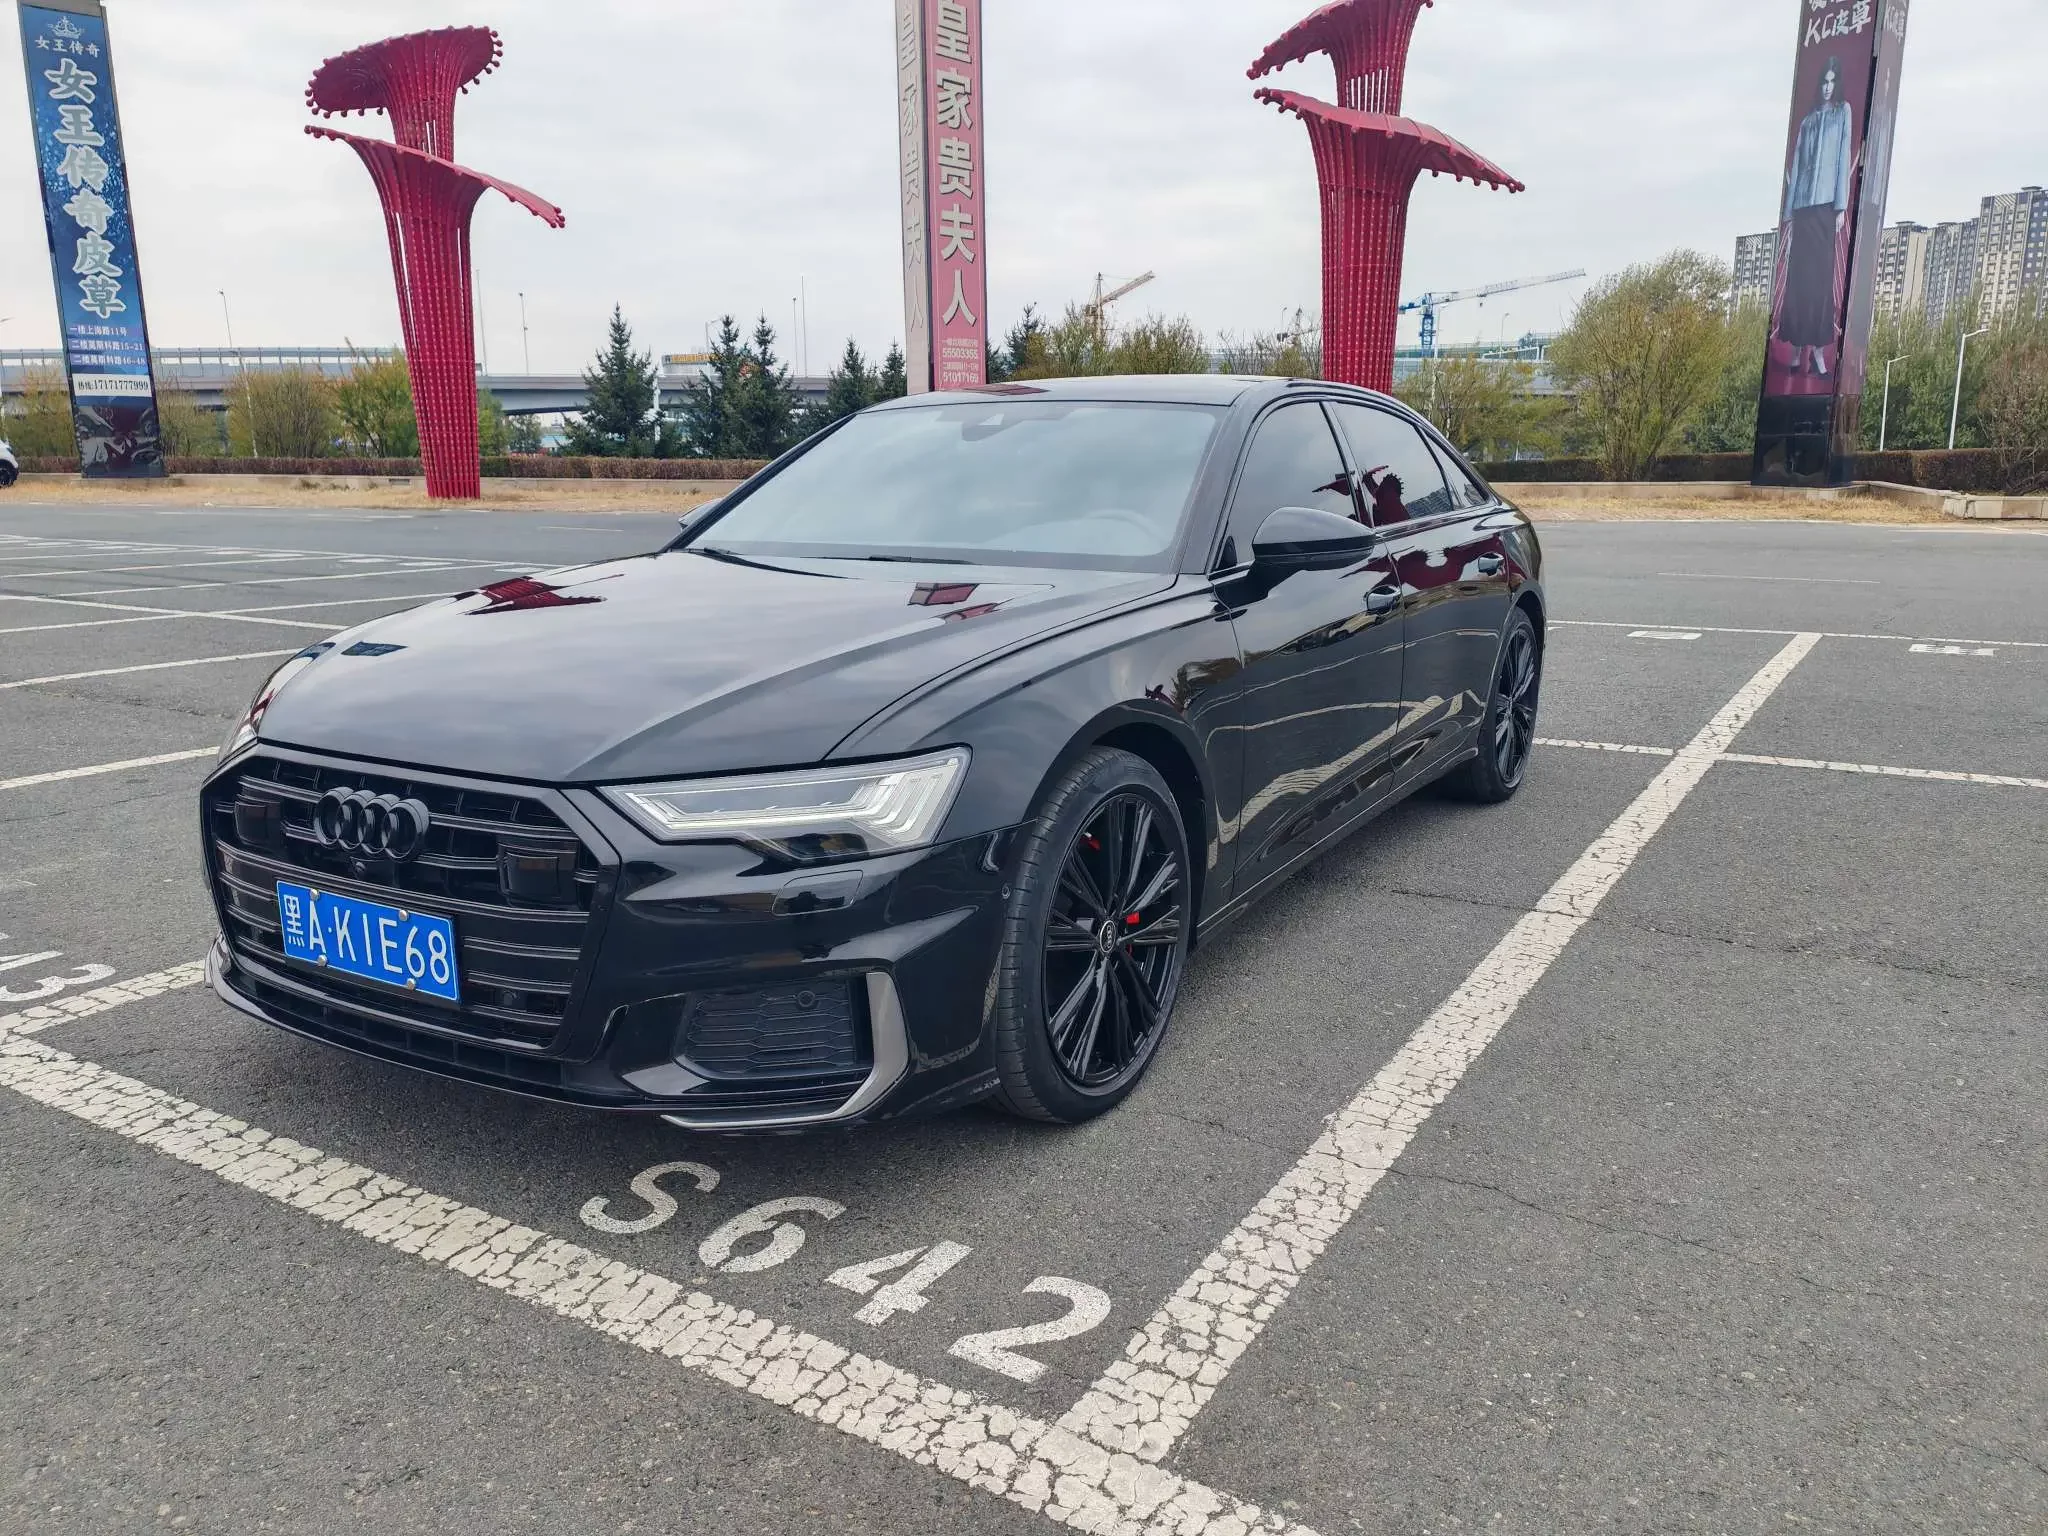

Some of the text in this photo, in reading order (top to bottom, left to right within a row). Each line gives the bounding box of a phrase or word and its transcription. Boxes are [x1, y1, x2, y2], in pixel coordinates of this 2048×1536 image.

[35, 36, 100, 58] 女王传奇
[935, 0, 977, 328] 皇家贵夫人
[44, 57, 127, 319] 女王传奇皮草
[579, 1161, 1112, 1383] S642
